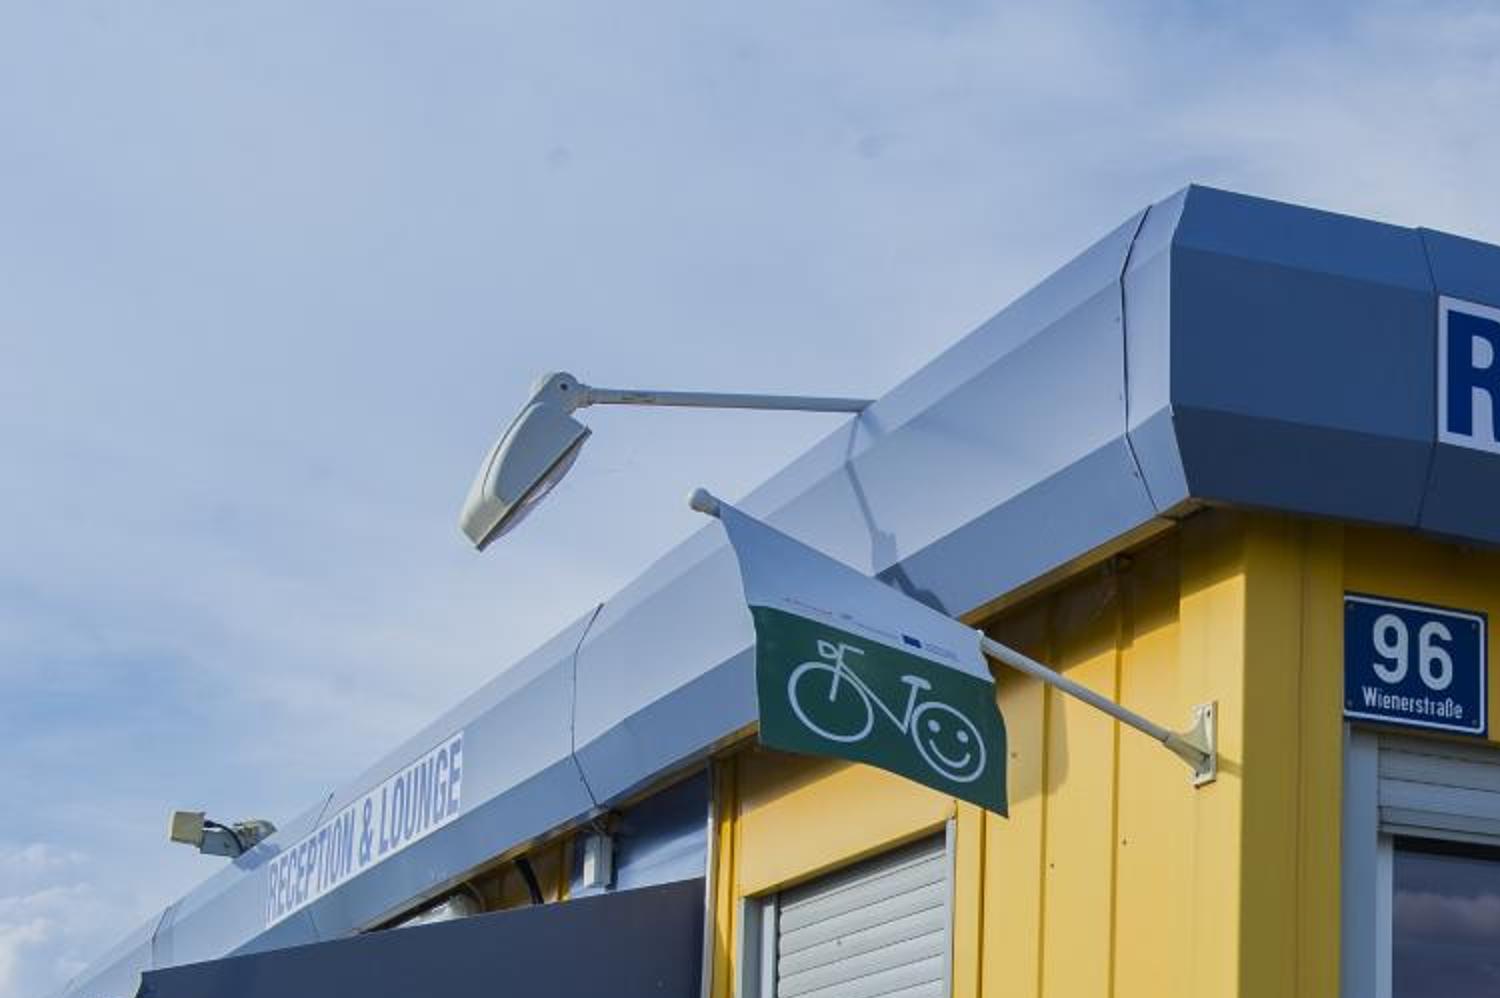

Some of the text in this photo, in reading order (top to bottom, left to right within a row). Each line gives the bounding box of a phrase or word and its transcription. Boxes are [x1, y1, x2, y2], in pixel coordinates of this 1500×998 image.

[1373, 613, 1453, 691] 96
[1362, 686, 1464, 719] Wienerstraße
[266, 739, 461, 927] RECEPTION & LOUNGE
